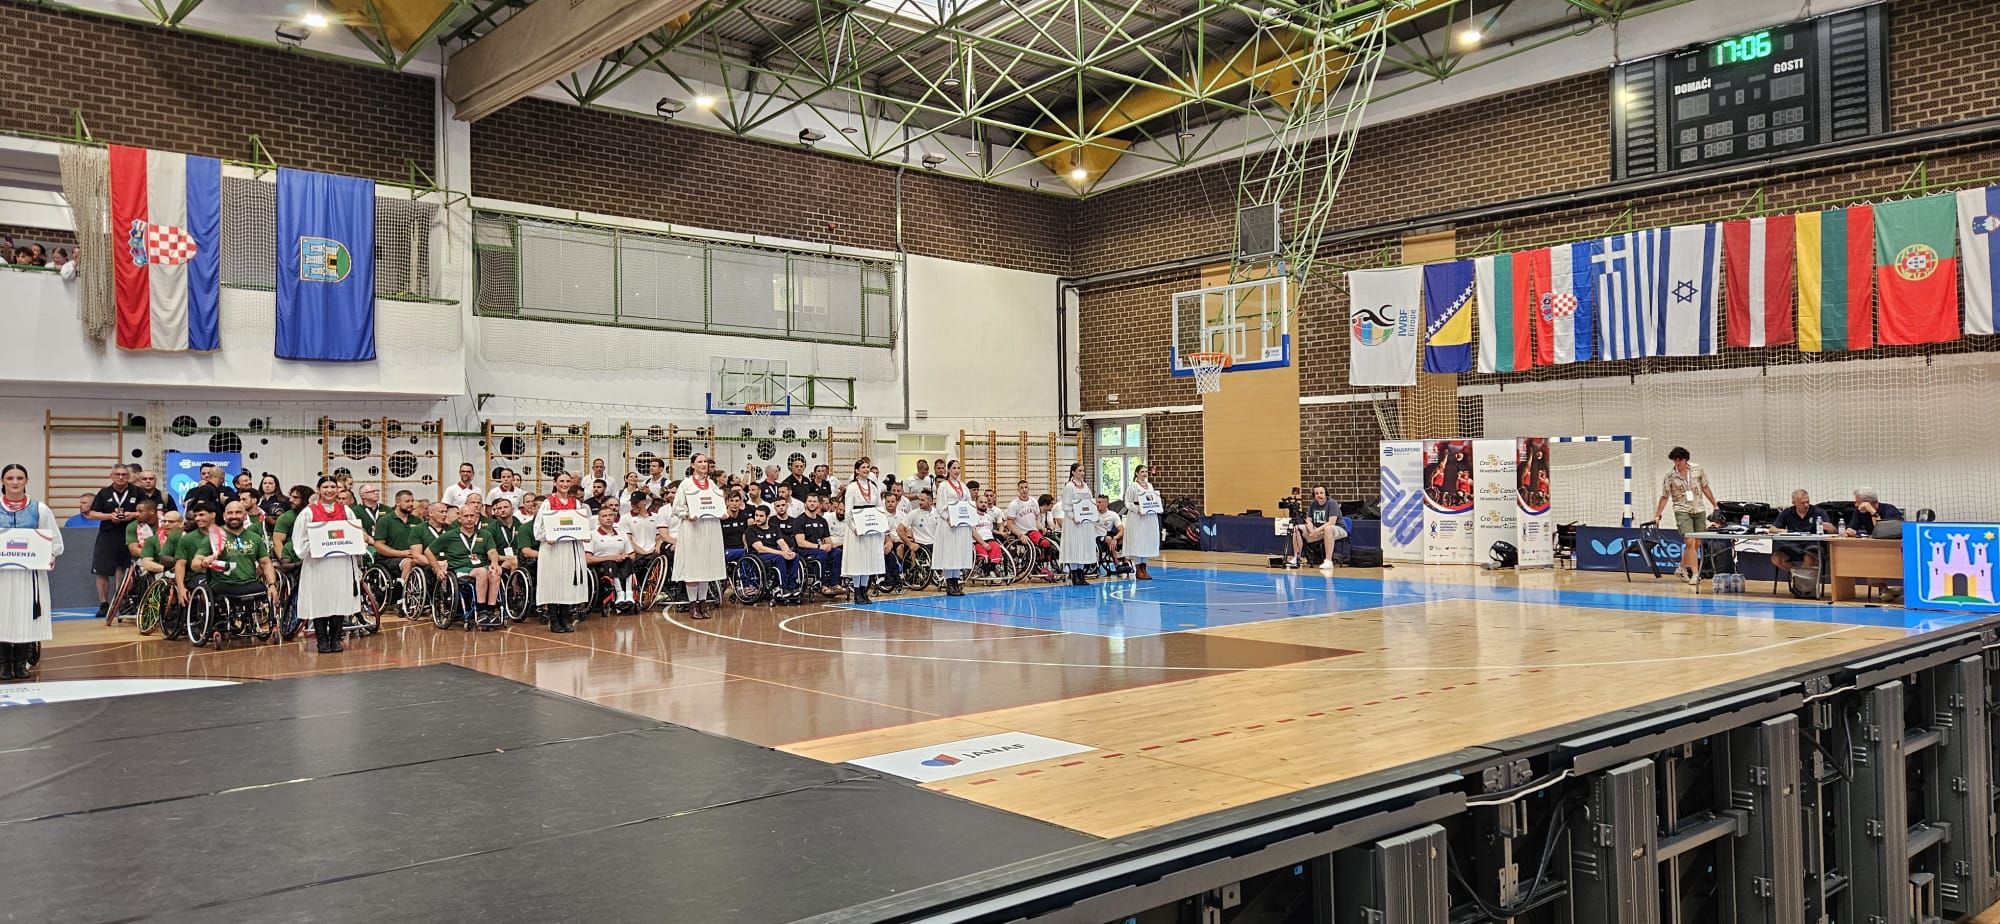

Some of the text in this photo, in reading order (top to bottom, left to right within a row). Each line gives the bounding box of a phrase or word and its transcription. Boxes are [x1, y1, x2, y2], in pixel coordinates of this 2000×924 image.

[1716, 31, 1771, 66] 17:06
[1773, 58, 1804, 74] GOSTI
[1674, 76, 1712, 96] DOMAĆI
[1397, 309, 1408, 337] IWBF
[1408, 309, 1417, 337] Europe
[321, 539, 354, 547] PORTUGAL
